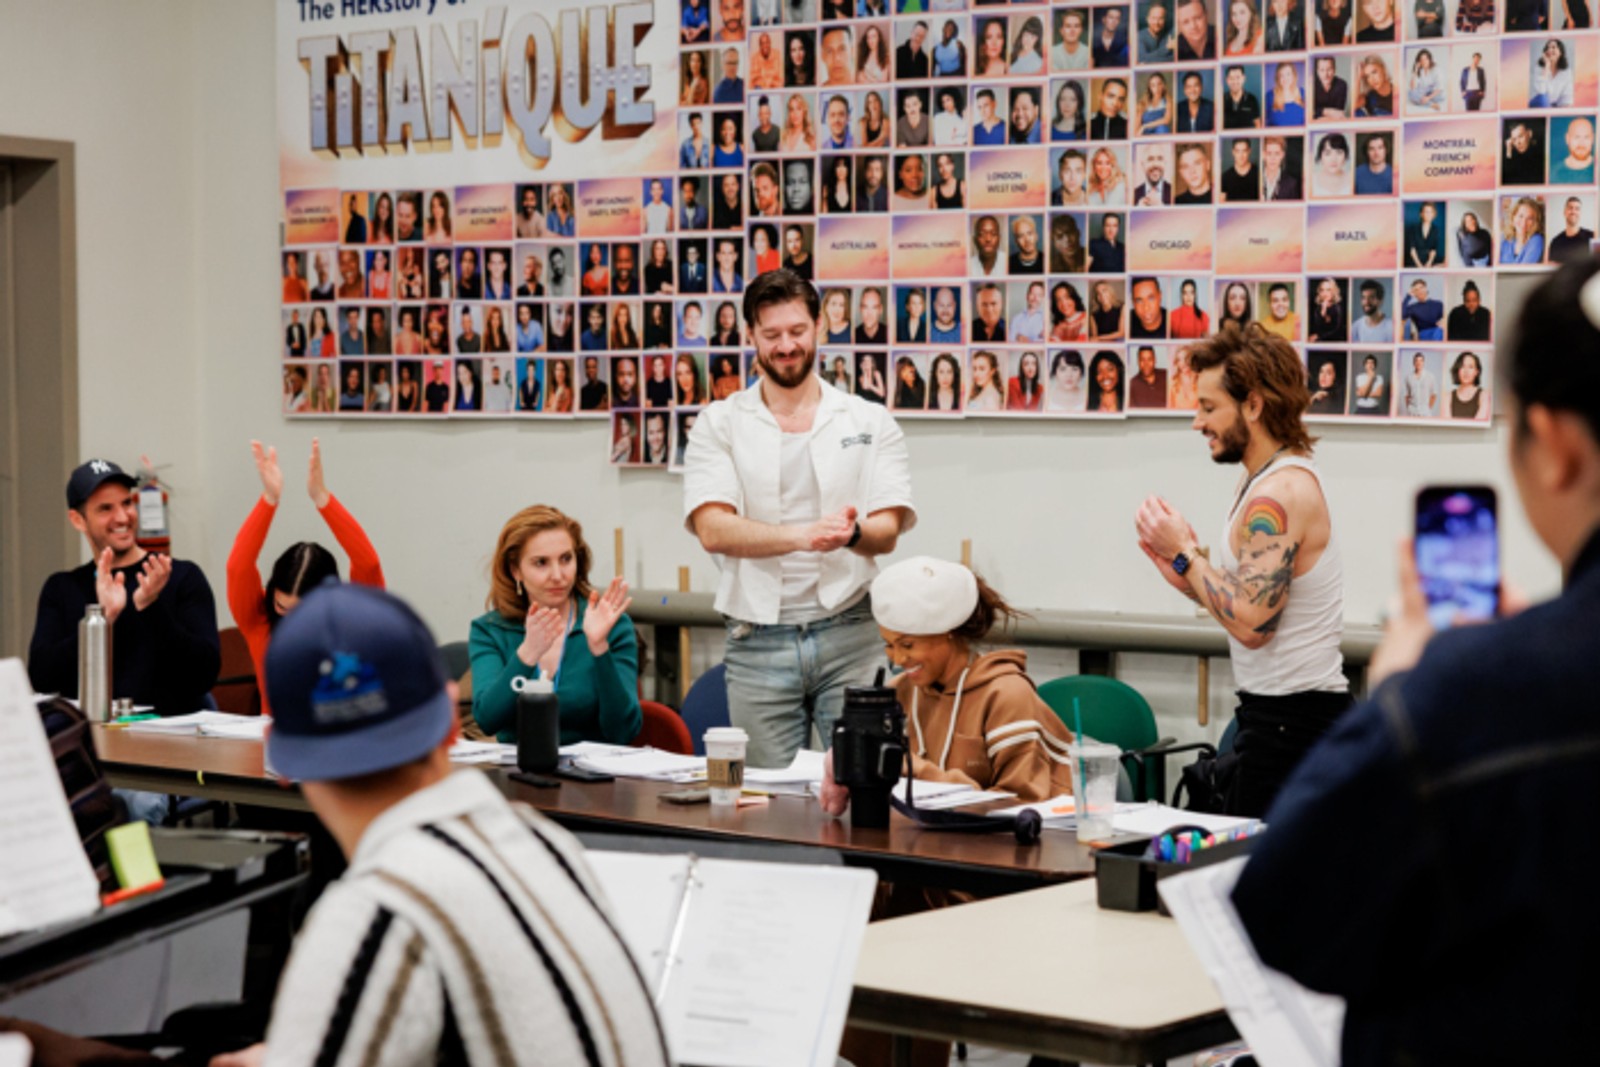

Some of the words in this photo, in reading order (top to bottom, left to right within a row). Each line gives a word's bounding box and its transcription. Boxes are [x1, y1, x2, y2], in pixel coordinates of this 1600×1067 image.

[297, 0, 335, 21] The
[1423, 138, 1476, 150] MONTREAL
[987, 170, 1023, 181] LONDON
[1424, 165, 1474, 177] COMPANY
[988, 182, 1009, 193] WEST
[1011, 182, 1028, 193] END
[1335, 230, 1368, 241] BRAZIL
[1149, 239, 1192, 250] CHICAGO
